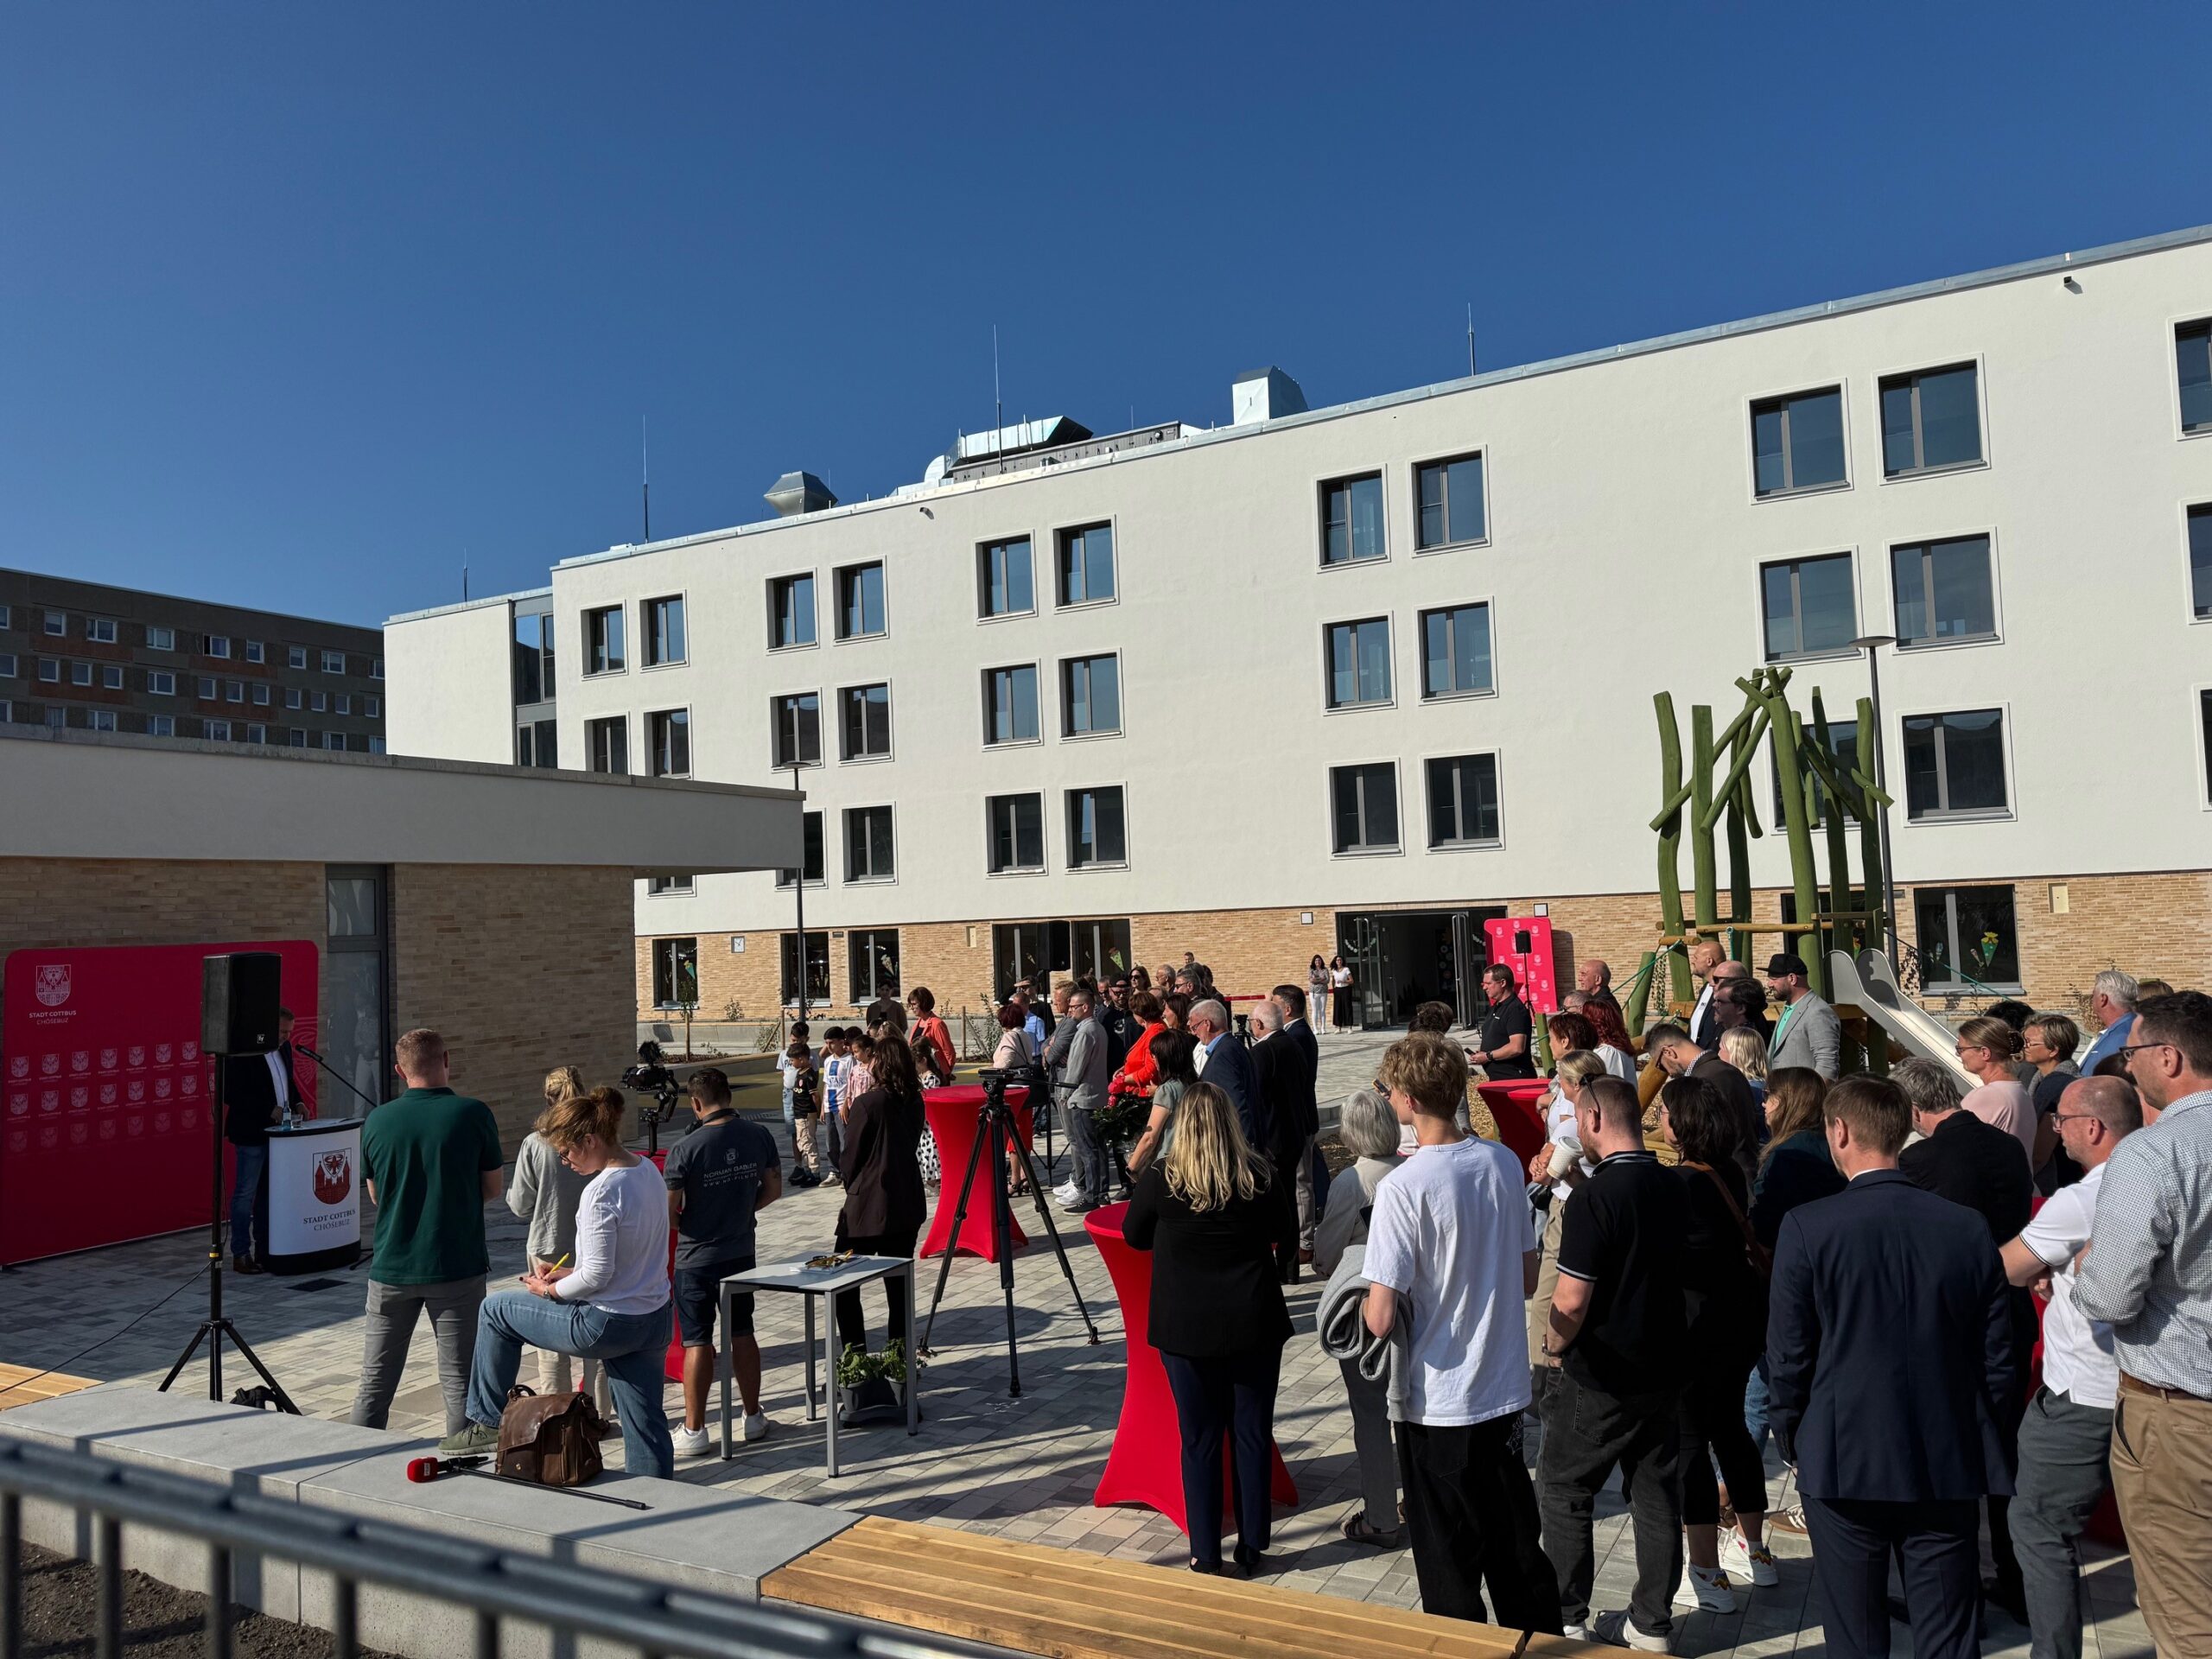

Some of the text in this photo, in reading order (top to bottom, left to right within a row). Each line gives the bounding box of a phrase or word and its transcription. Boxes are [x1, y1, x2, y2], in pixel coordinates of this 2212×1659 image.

[703, 1168, 732, 1179] NORMAN
[733, 1162, 757, 1172] GABLER
[303, 1210, 356, 1224] STADT COTTBUS
